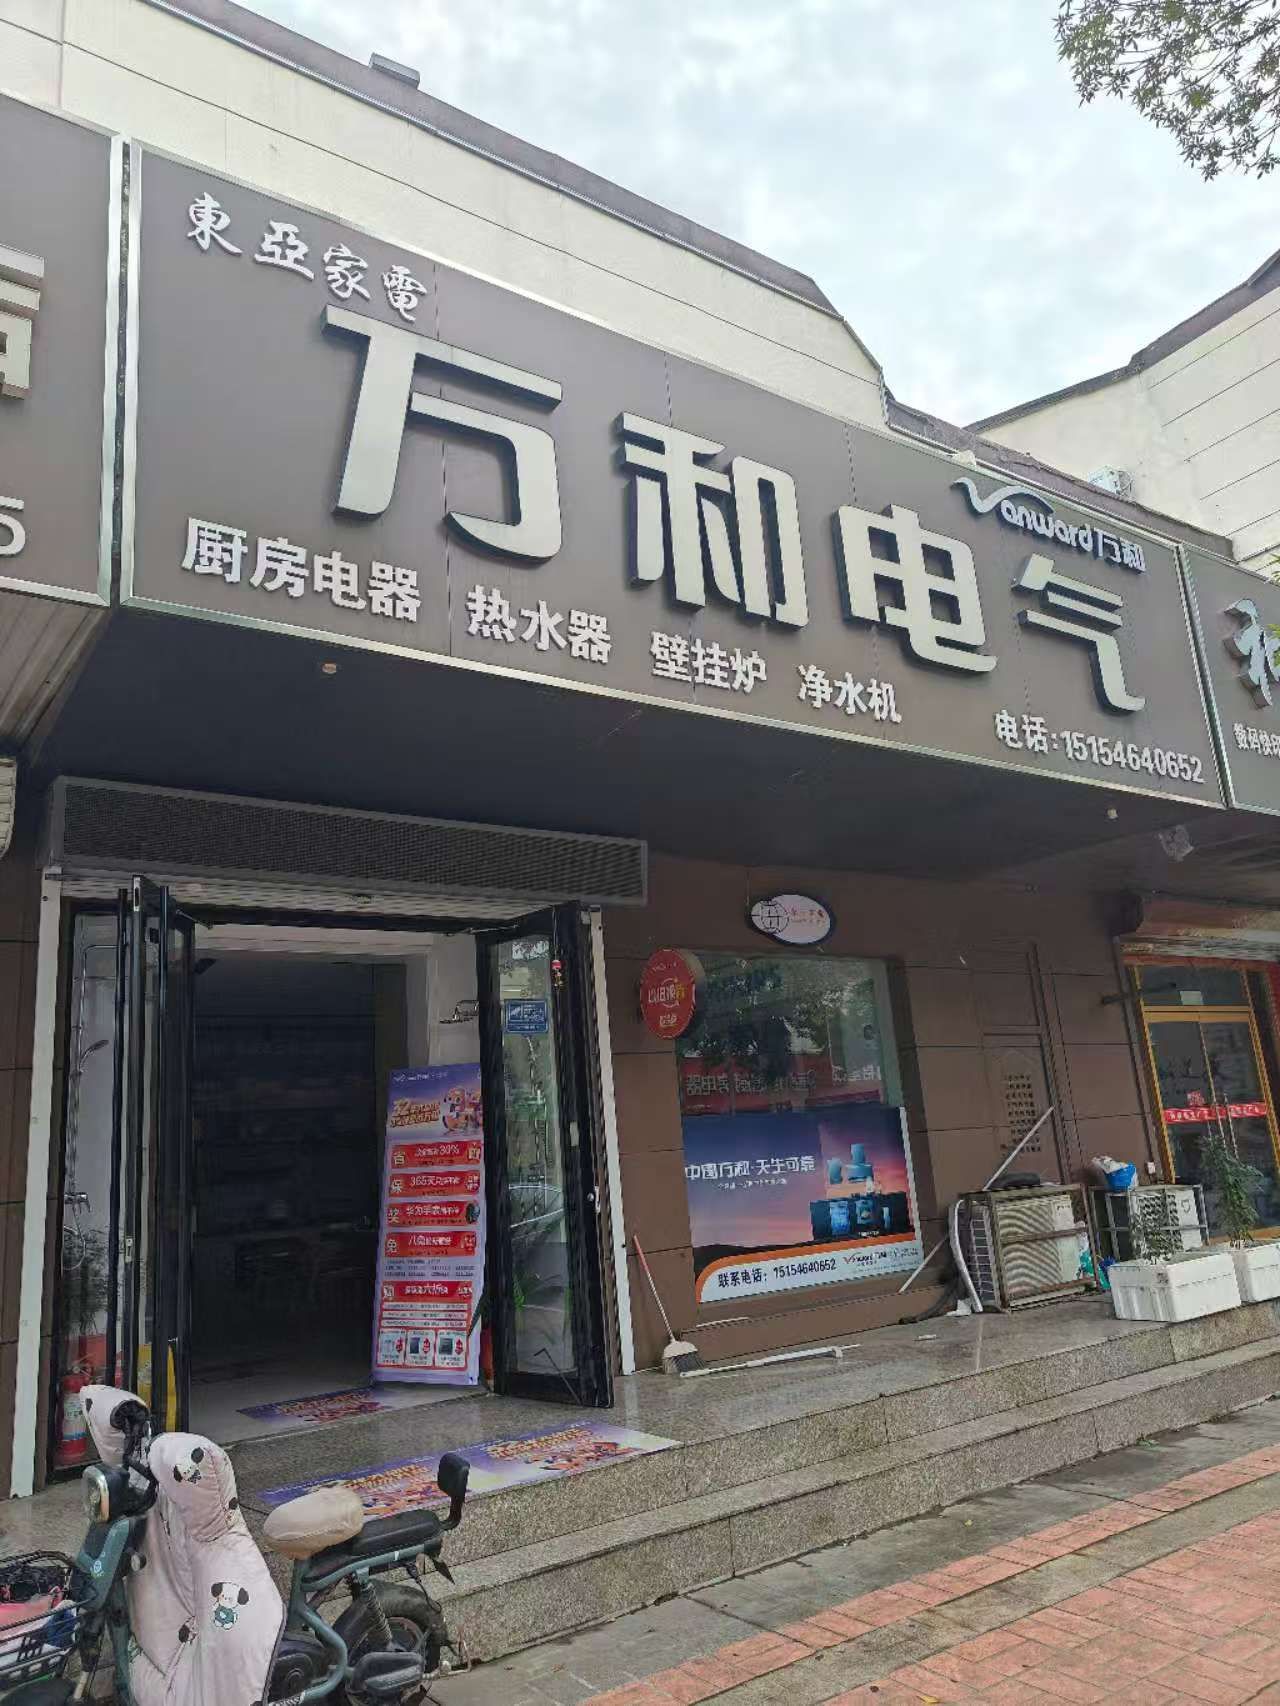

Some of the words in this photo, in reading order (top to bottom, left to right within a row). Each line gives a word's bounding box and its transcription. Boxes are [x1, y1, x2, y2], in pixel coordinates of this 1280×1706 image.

[322, 303, 1146, 714] 万和电气
[181, 518, 421, 622] 厨房电器
[465, 585, 612, 664] 热水器
[649, 631, 768, 693] 壁挂炉
[797, 664, 902, 724] 净水机
[994, 710, 1205, 784] 电话:15154640652
